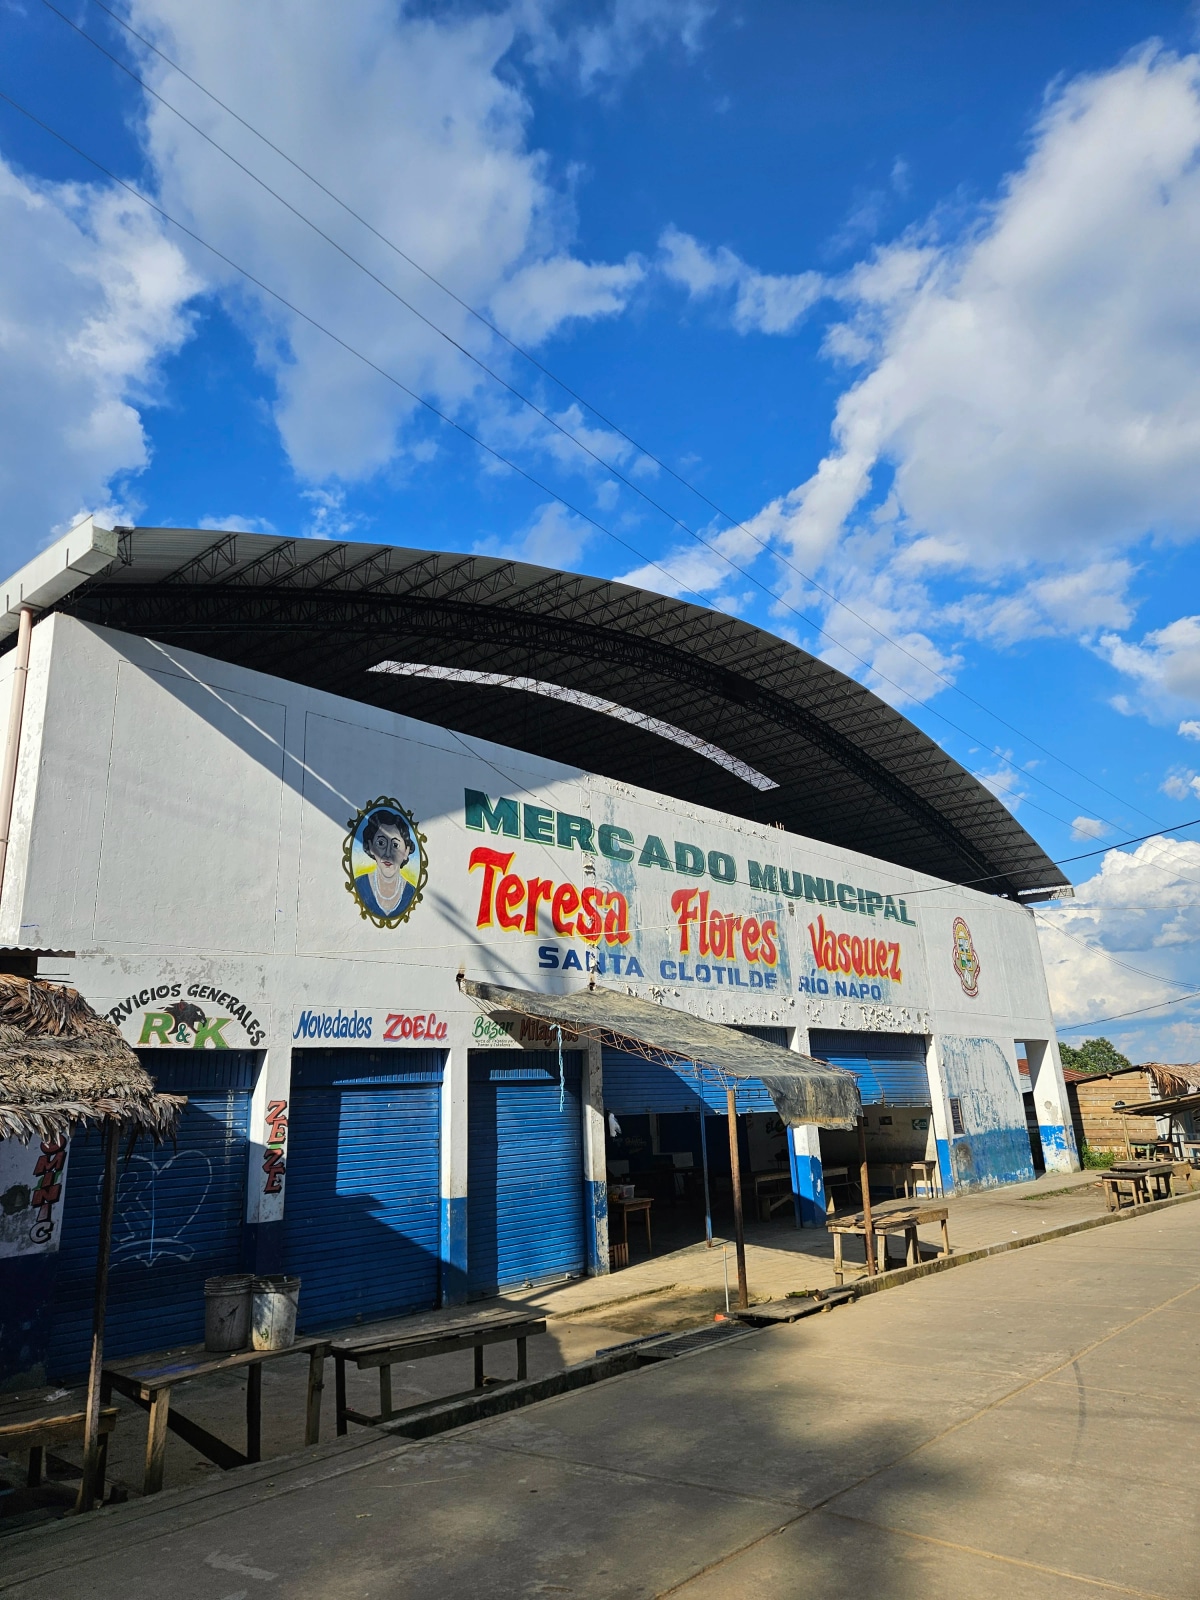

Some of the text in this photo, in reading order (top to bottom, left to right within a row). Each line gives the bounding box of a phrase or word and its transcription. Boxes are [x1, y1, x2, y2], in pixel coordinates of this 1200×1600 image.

[464, 788, 917, 927] MERCADO MUNICIPAL
[468, 847, 633, 947] Teresa
[671, 887, 778, 968] Flores
[807, 914, 902, 984] Vasquez
[538, 946, 882, 1001] SANTA CLOTILDE RÍO NAPO
[187, 984, 266, 1046] GENERALES
[293, 1009, 373, 1040] Novedades
[472, 1014, 515, 1040] Bazar
